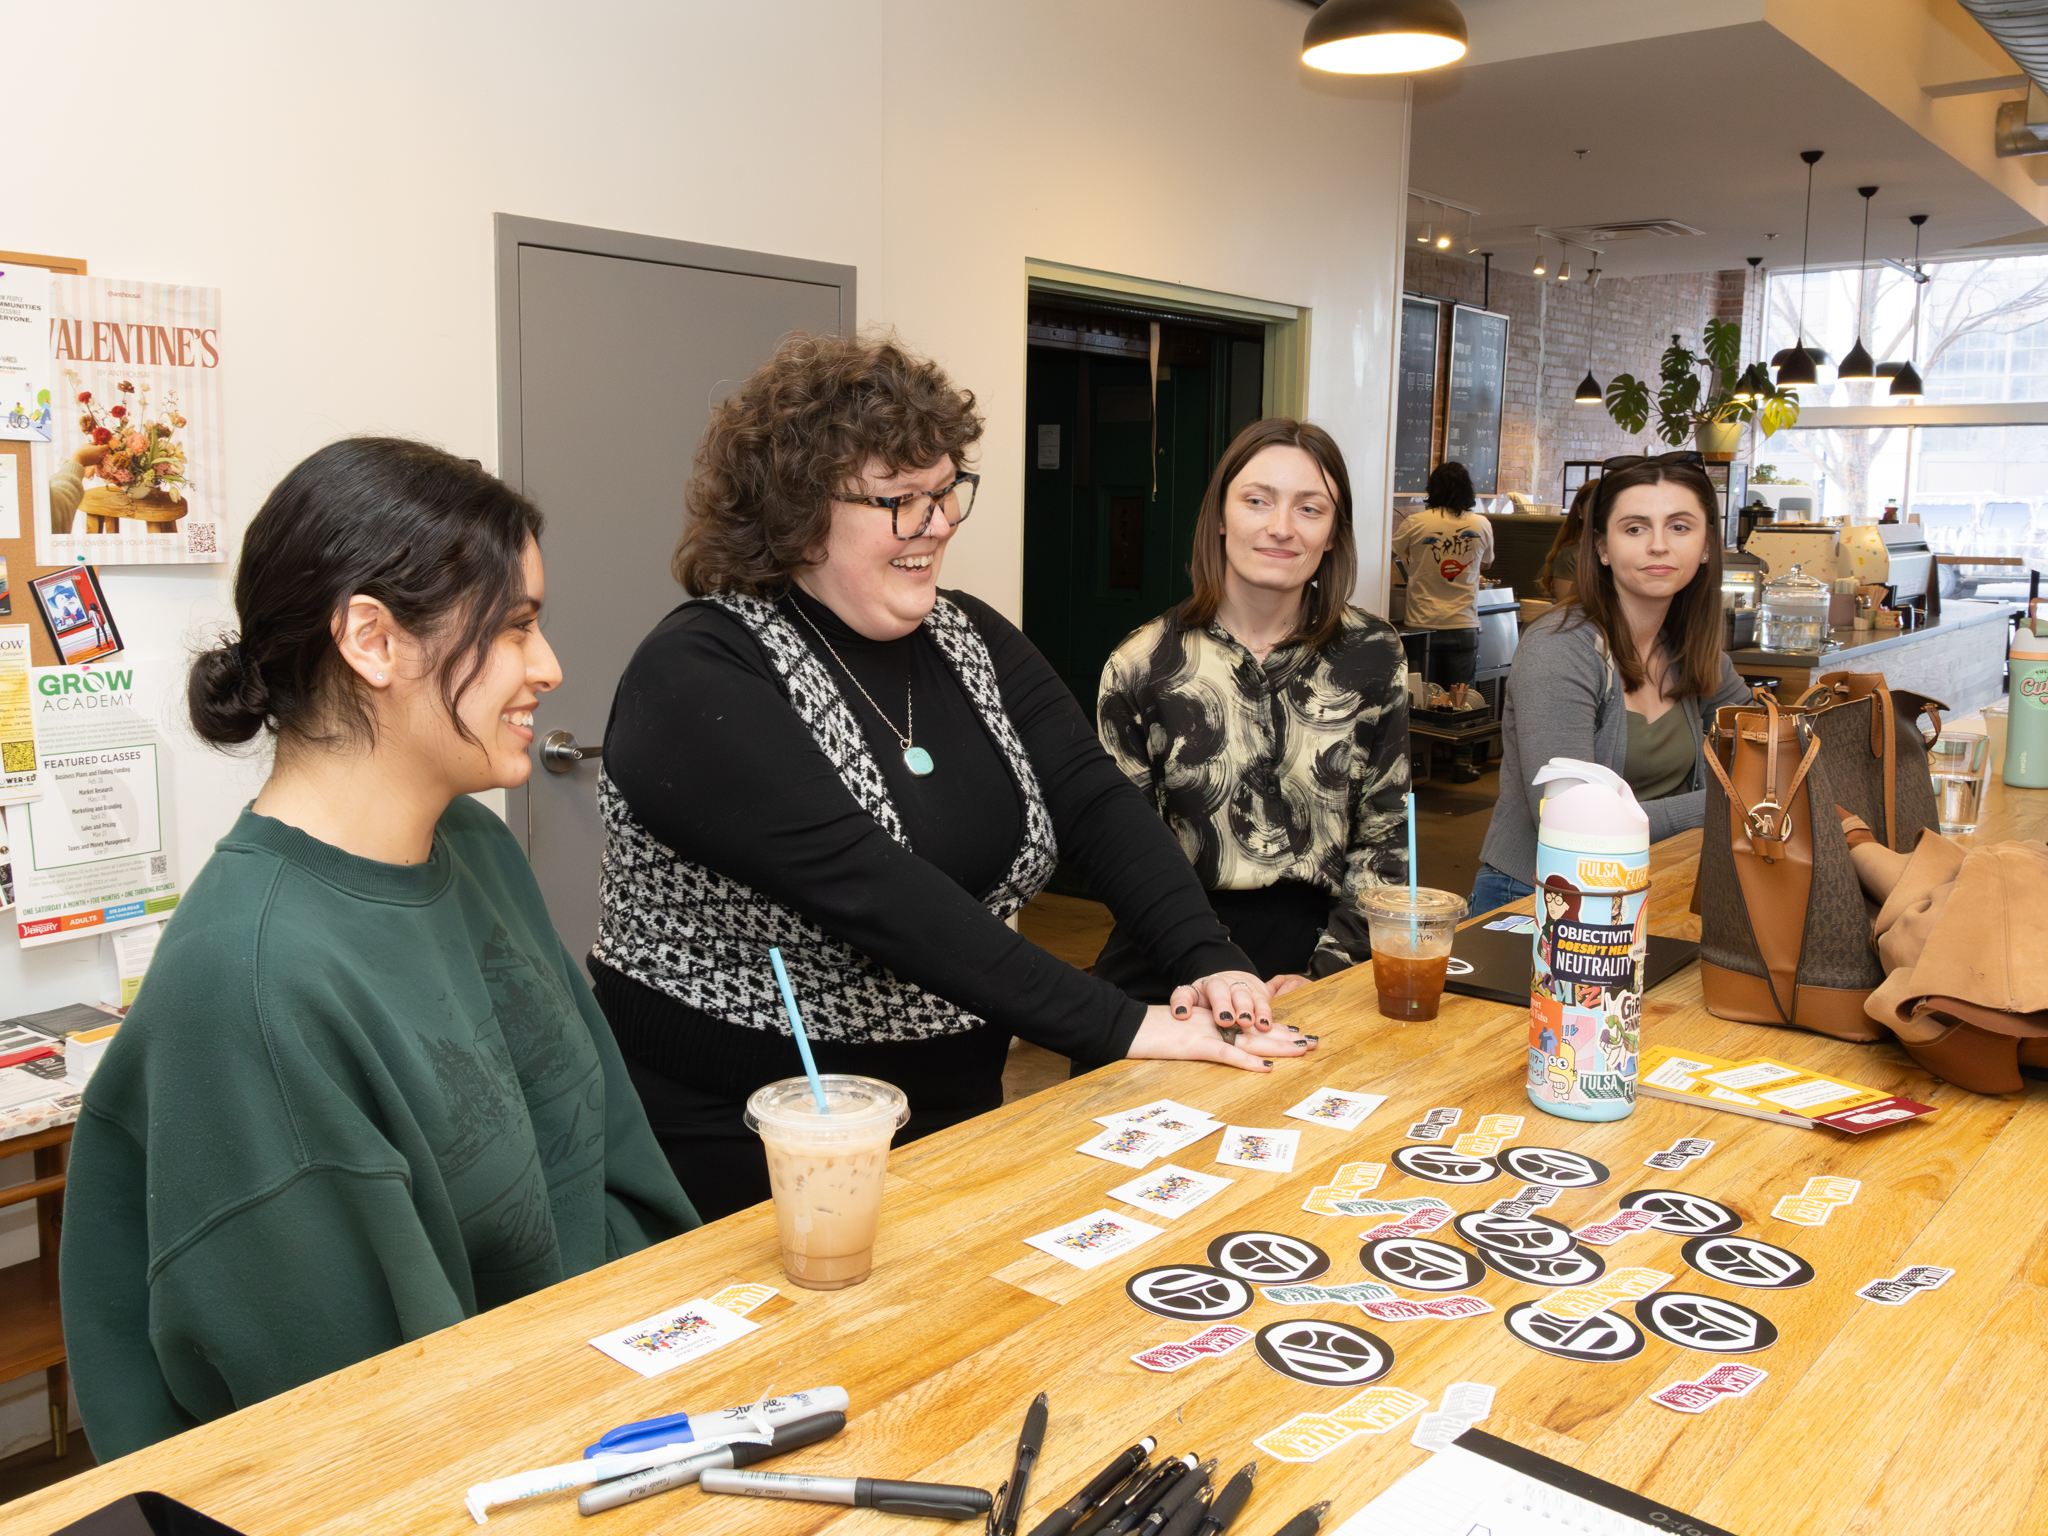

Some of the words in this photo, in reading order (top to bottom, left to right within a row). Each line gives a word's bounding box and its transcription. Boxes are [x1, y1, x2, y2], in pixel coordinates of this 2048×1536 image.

[108, 370, 150, 378] ANTHOUSAI
[52, 540, 76, 548] ORDER
[145, 538, 172, 546] SWEETIE
[38, 670, 133, 696] GROW
[42, 693, 134, 712] ACADEMY
[44, 756, 98, 769] FEATURED
[100, 751, 142, 763] CLASSES
[98, 768, 114, 776] Finding
[78, 788, 94, 796] Market
[95, 786, 114, 794] Research
[104, 838, 130, 846] Management
[1580, 860, 1619, 879] TULSA
[23, 908, 34, 916] ONE
[34, 903, 62, 914] SATURDAY
[68, 899, 86, 908] MONTH
[90, 896, 100, 904] FIVE
[101, 892, 120, 902] MONTHS
[124, 890, 134, 898] ONE
[134, 886, 156, 896] THRIVING
[156, 882, 176, 892] BUSINESS
[70, 914, 98, 926] ADULTS
[1557, 924, 1634, 944] OBJECTIVITY
[1557, 938, 1608, 956] DOESN'T
[1556, 950, 1632, 976] NEUTRALITY
[1581, 1074, 1618, 1092] TULSA
[1492, 1115, 1521, 1134] TULSA
[1470, 1134, 1499, 1154] FLYER
[1688, 1139, 1712, 1156] TULSA
[1352, 1164, 1380, 1186] TULSA
[1534, 1186, 1557, 1204] TULSA
[1825, 1178, 1857, 1199] TULSA
[1352, 1202, 1389, 1214] FLYER
[1798, 1198, 1830, 1222] FLYER
[1422, 1208, 1451, 1228] TULSA
[1626, 1210, 1656, 1230] TULSA
[1595, 1226, 1624, 1243] FLYER
[1618, 1270, 1668, 1296] TULSA
[1915, 1266, 1949, 1286] TULSA
[1282, 1290, 1326, 1302] FLYER
[1336, 1286, 1392, 1300] TULSA
[1878, 1282, 1916, 1301] FLYER
[1381, 1303, 1429, 1317] FLYER
[1438, 1298, 1490, 1316] TULSA
[1561, 1290, 1614, 1316] FLYER
[1204, 1327, 1250, 1350] TULSA
[1155, 1346, 1200, 1367] FLYER
[1719, 1366, 1762, 1392] TULSA
[1462, 1386, 1492, 1414] TULSA
[1676, 1385, 1718, 1408] FLYER
[1360, 1392, 1422, 1428] TULSA
[1286, 1418, 1354, 1456] FLYER
[1648, 1512, 1710, 1536] Oxfo
